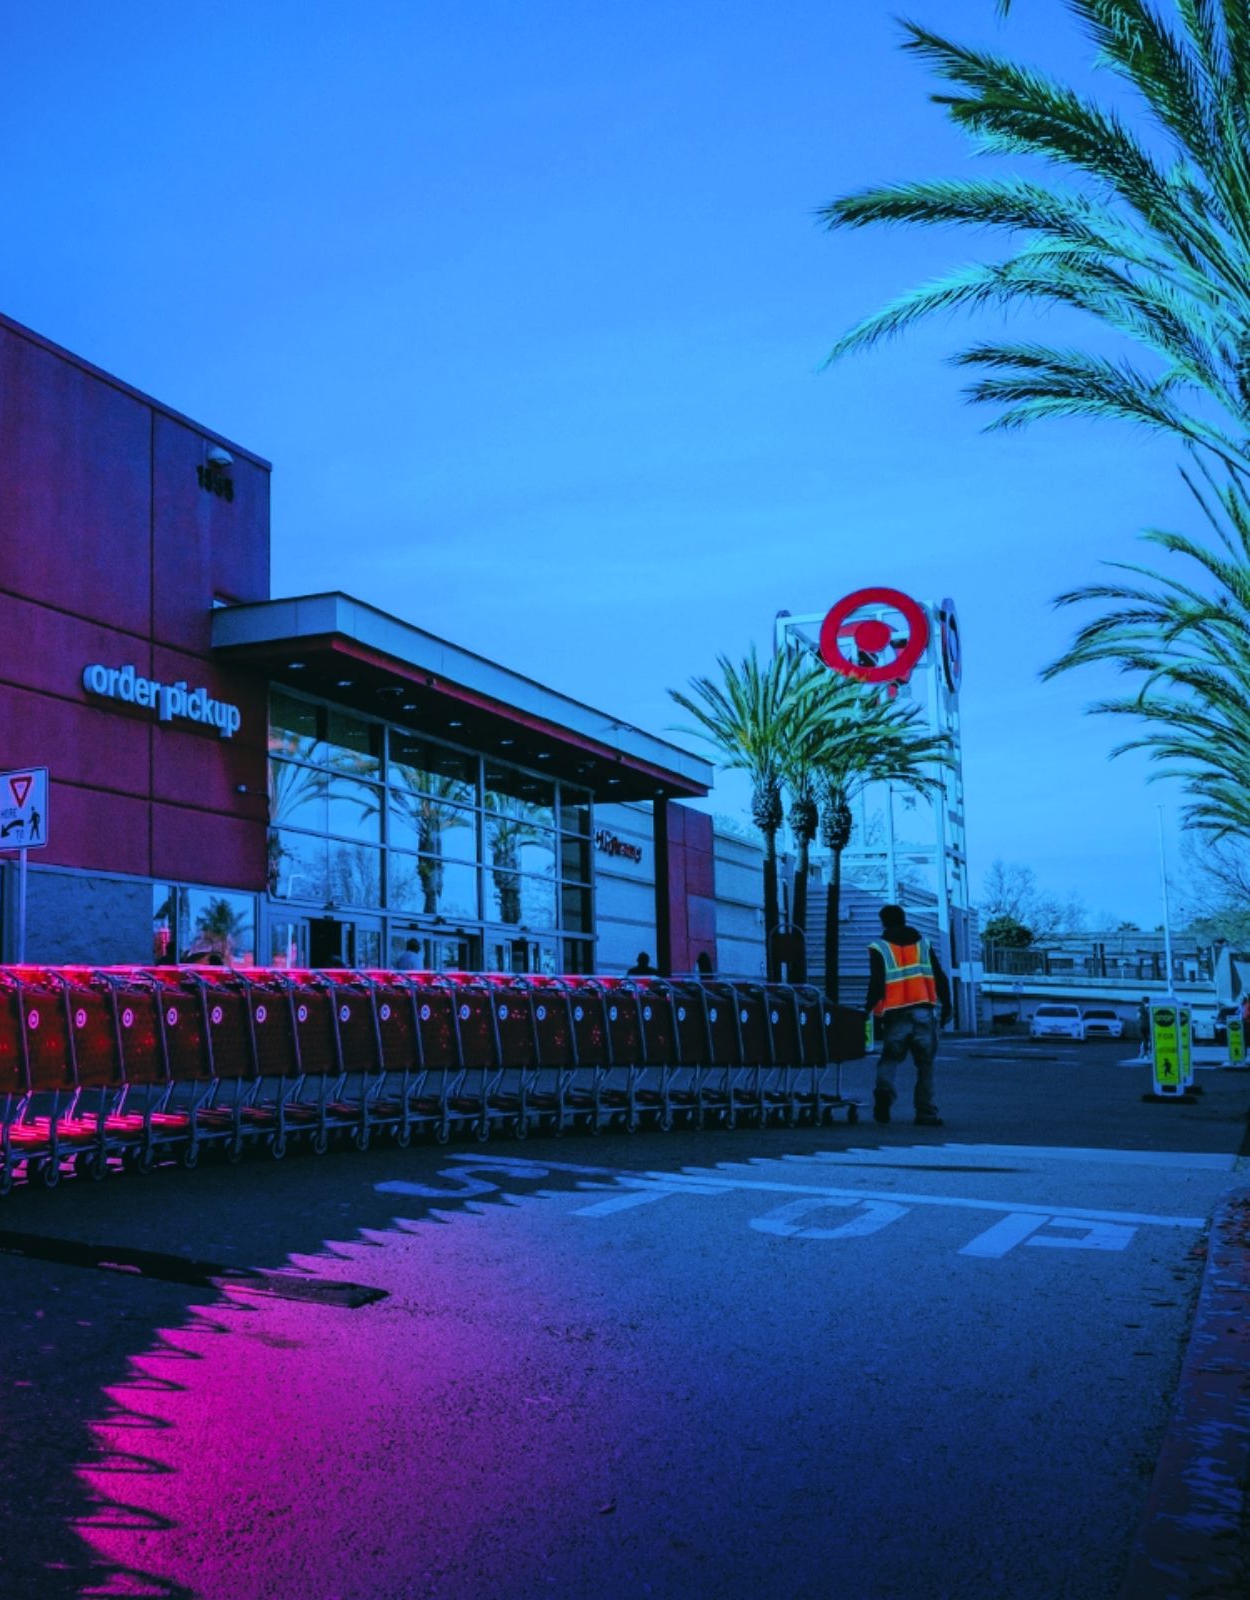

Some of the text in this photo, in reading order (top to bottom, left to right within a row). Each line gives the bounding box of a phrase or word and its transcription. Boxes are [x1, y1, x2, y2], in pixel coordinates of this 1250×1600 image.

[83, 664, 241, 738] order pickup
[0, 808, 18, 819] HERE
[374, 1165, 1137, 1258] STOP
